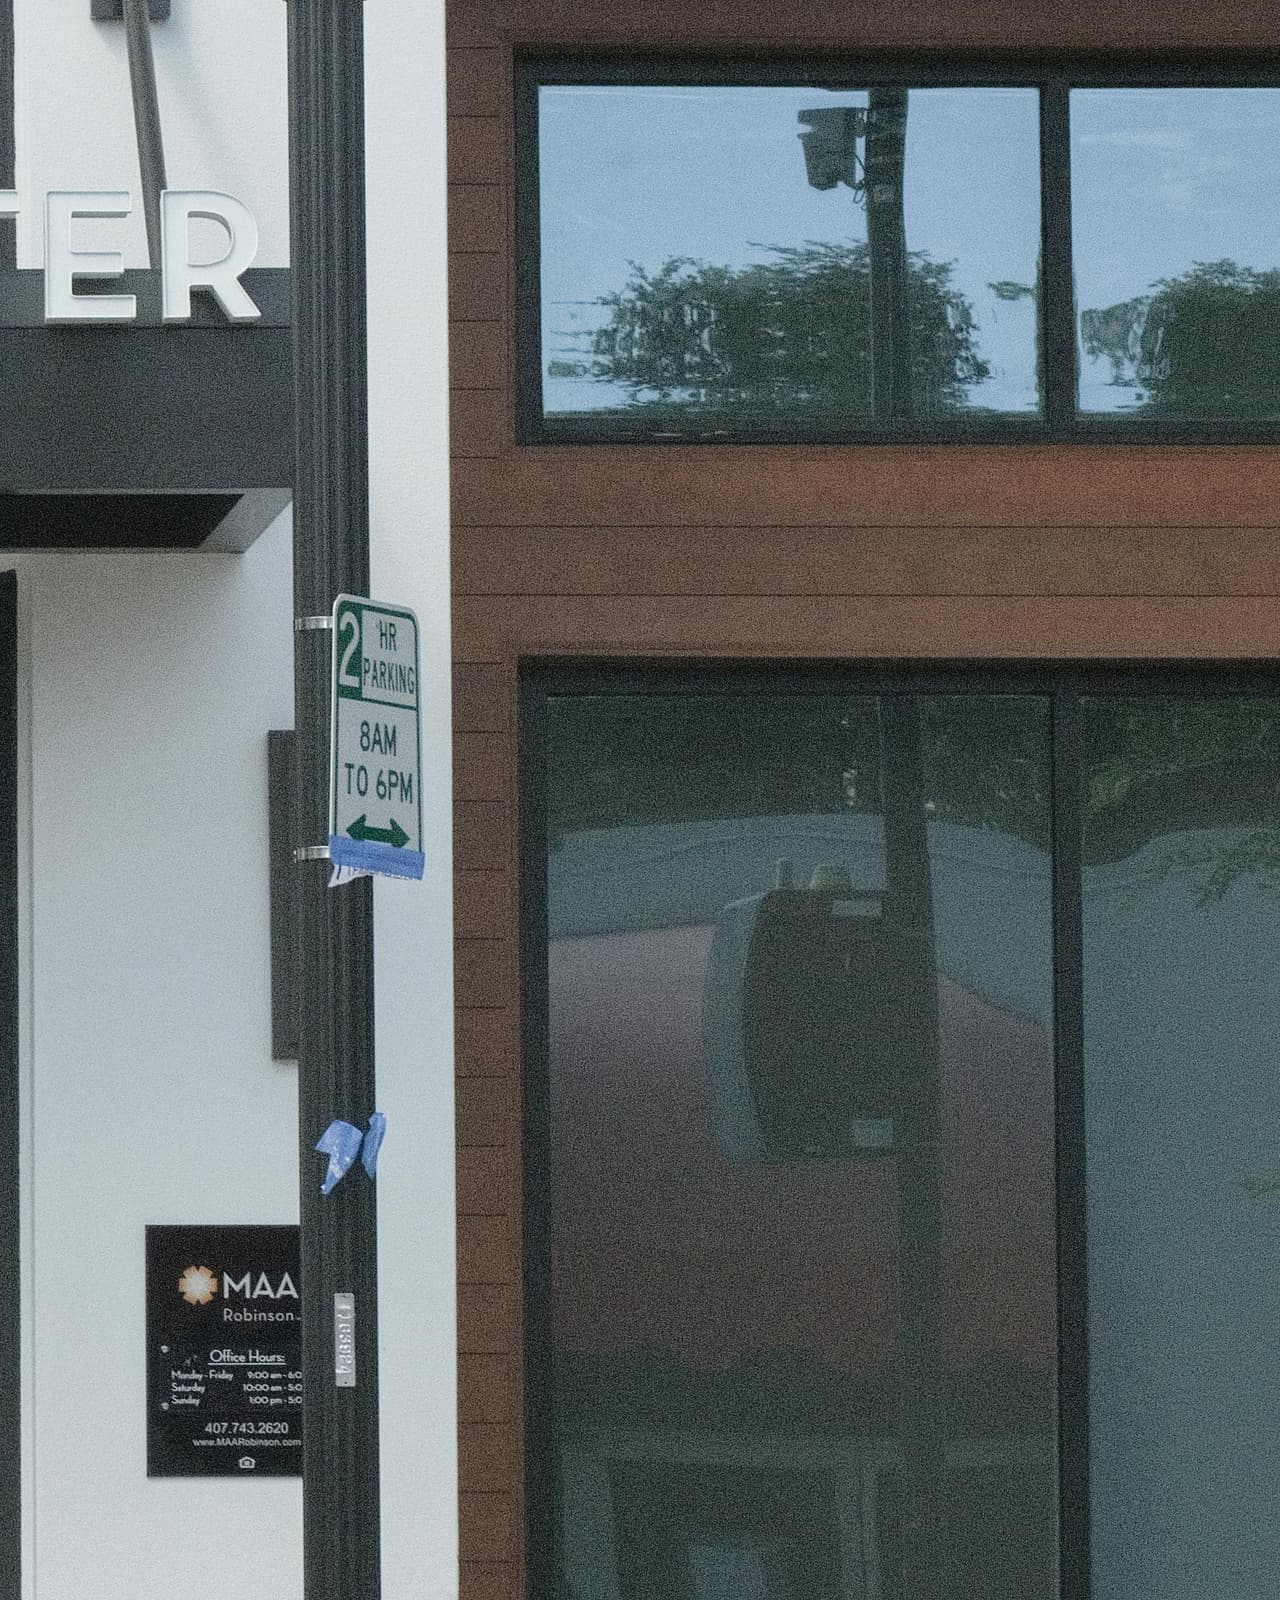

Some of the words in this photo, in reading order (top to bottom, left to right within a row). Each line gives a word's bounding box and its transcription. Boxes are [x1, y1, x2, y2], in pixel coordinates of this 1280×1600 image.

[379, 619, 397, 651] HR
[338, 609, 361, 688] 2
[363, 656, 415, 695] PARKING
[360, 719, 397, 757] 8AM
[344, 762, 369, 797] TO
[375, 769, 413, 804] 6PM
[223, 1271, 299, 1299] MAA
[223, 1308, 295, 1322] Robinson
[210, 1349, 246, 1363] Office
[249, 1349, 285, 1363] Hours:
[171, 1370, 203, 1381] Monday
[209, 1370, 234, 1381] Friday
[171, 1382, 206, 1394] Saturday
[171, 1394, 201, 1406] Sunday
[204, 1422, 289, 1434] 407.743.2620
